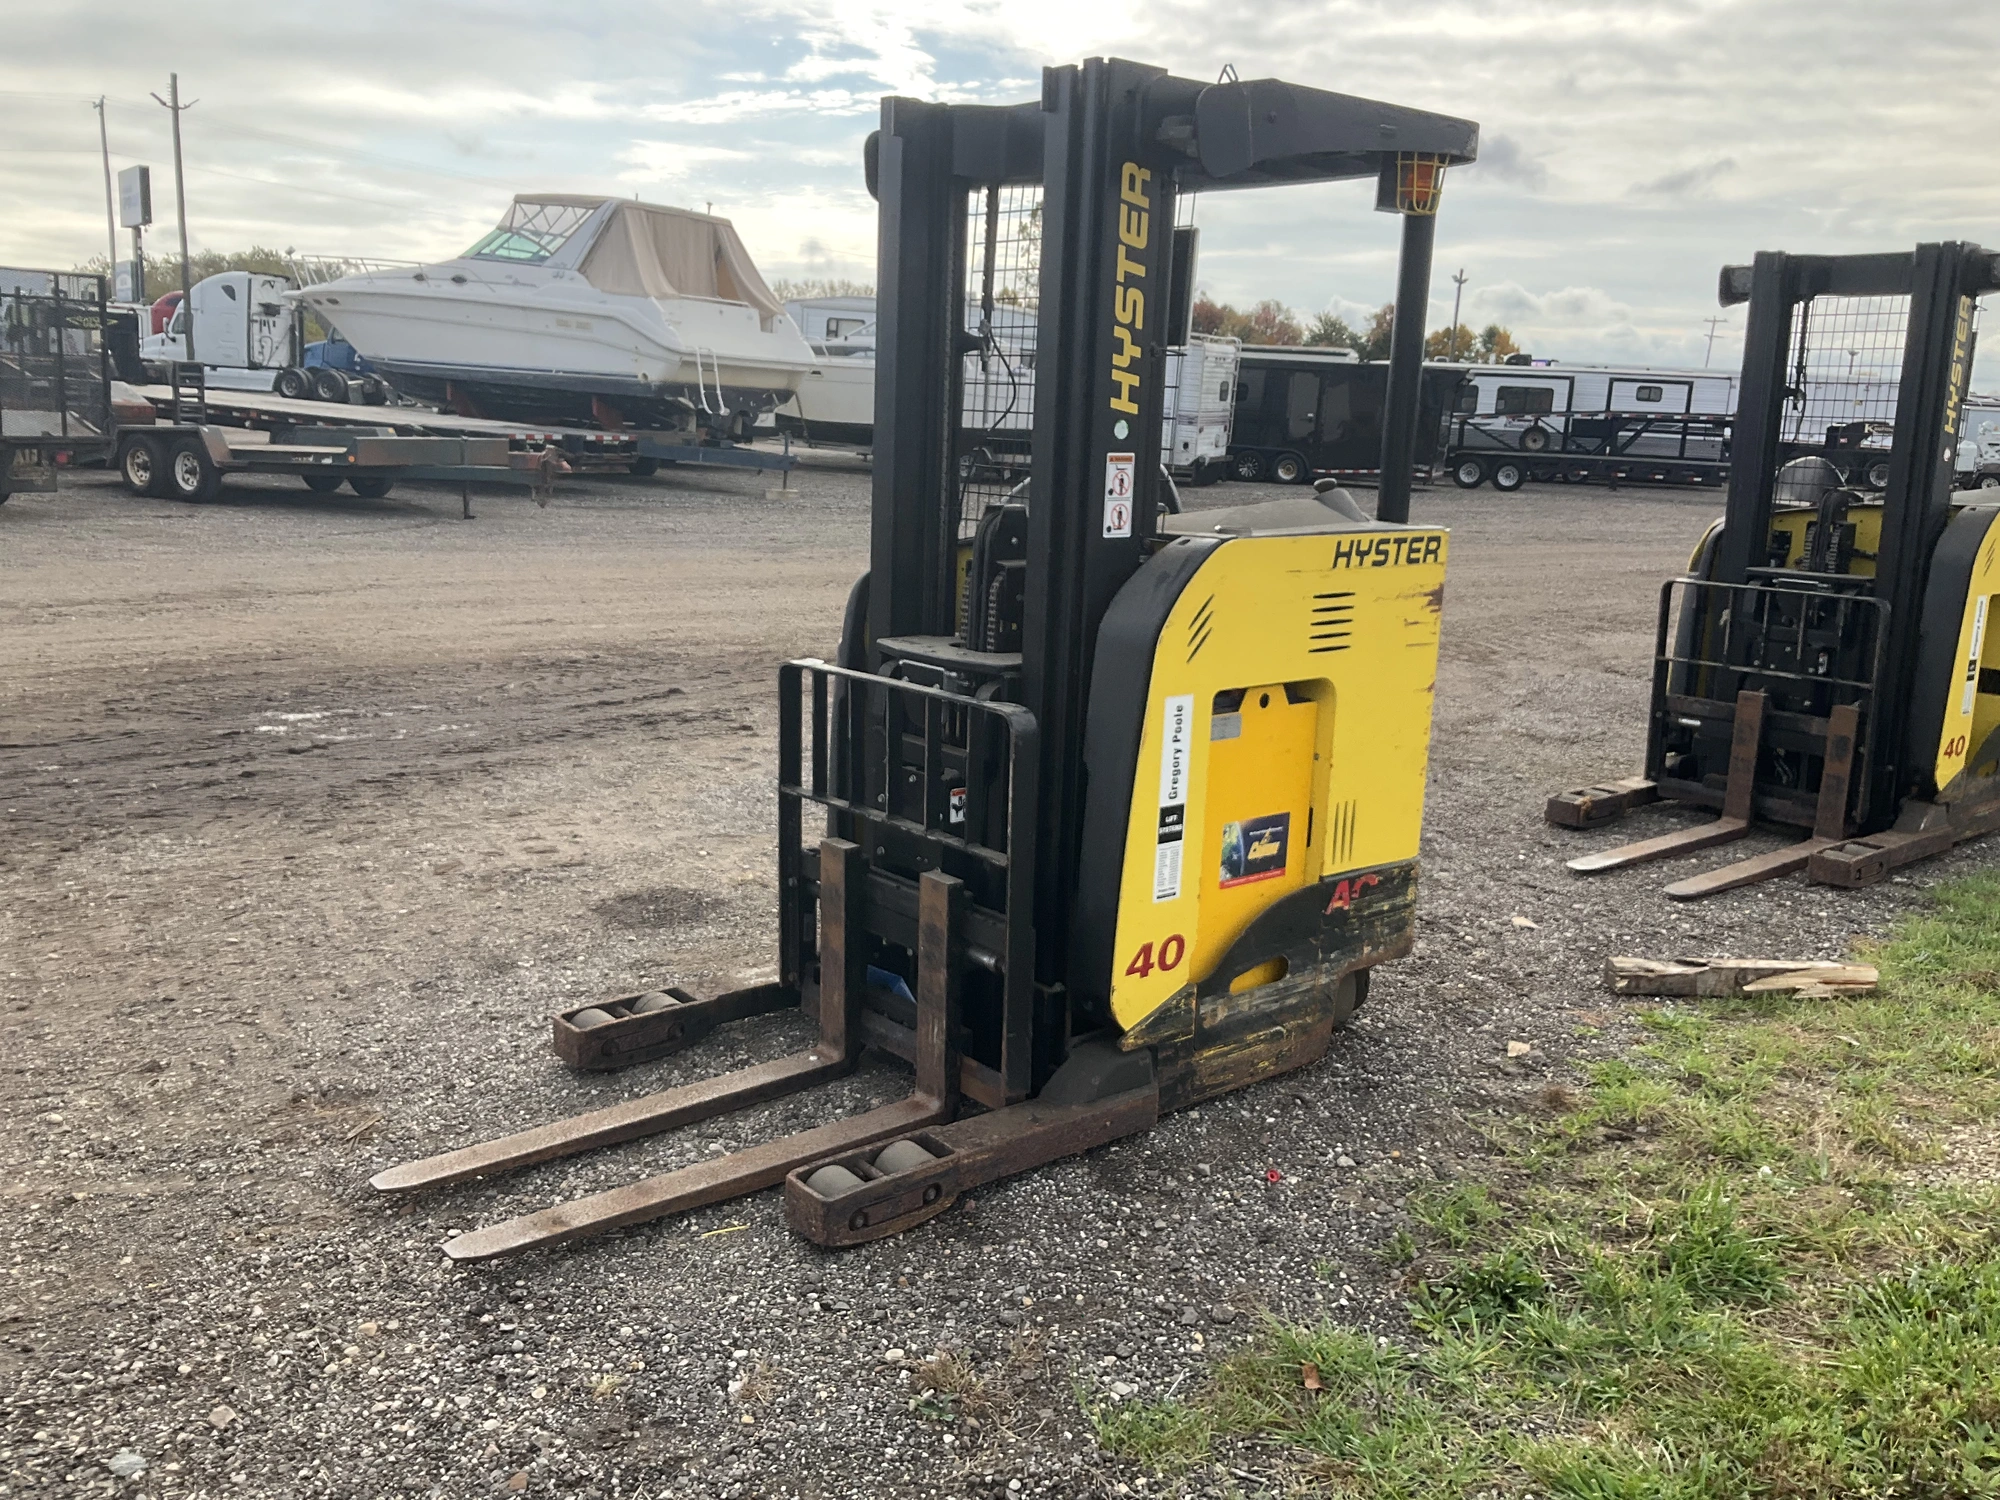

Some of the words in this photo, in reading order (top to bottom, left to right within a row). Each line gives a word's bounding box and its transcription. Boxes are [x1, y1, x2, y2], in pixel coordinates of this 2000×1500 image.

[1110, 161, 1152, 415] HYSTER
[1943, 294, 1972, 435] HYSTER
[1332, 535, 1442, 569] HYSTER
[1172, 704, 1184, 743] Poole
[1943, 734, 1966, 759] 40
[1168, 747, 1183, 800] Gregory
[1125, 933, 1185, 979] 40
